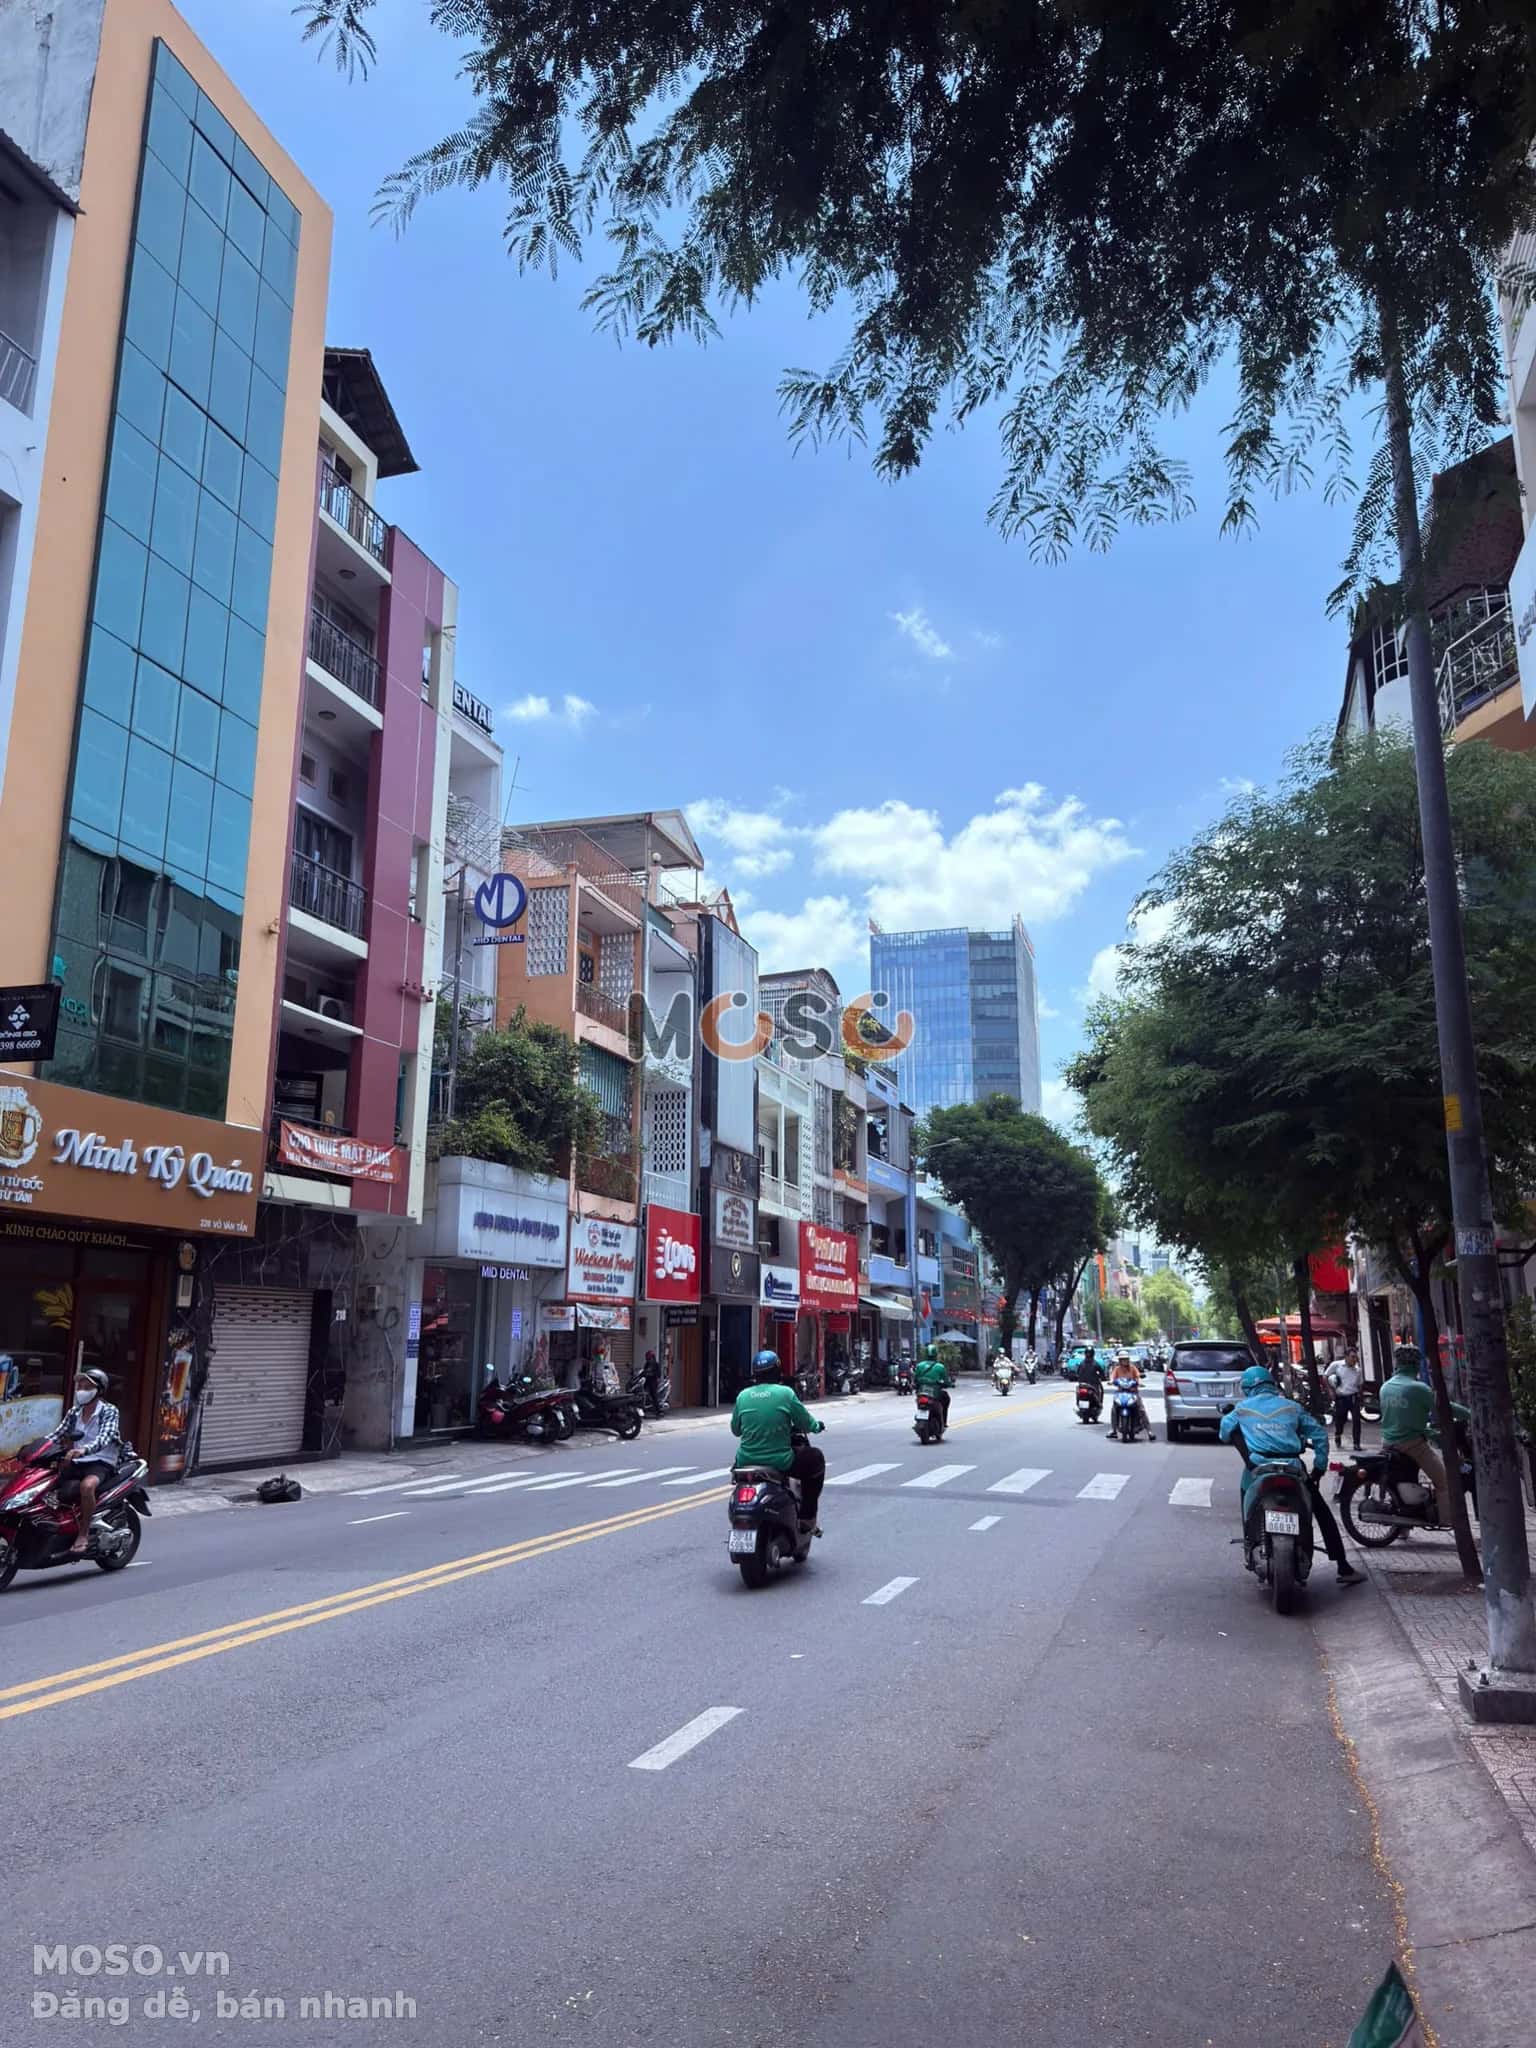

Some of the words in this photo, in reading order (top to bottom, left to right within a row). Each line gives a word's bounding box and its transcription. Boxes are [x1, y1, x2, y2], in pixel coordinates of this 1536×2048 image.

[53, 1129, 138, 1175] Minh
[186, 1152, 254, 1198] Quán
[499, 1267, 529, 1281] DENTAL
